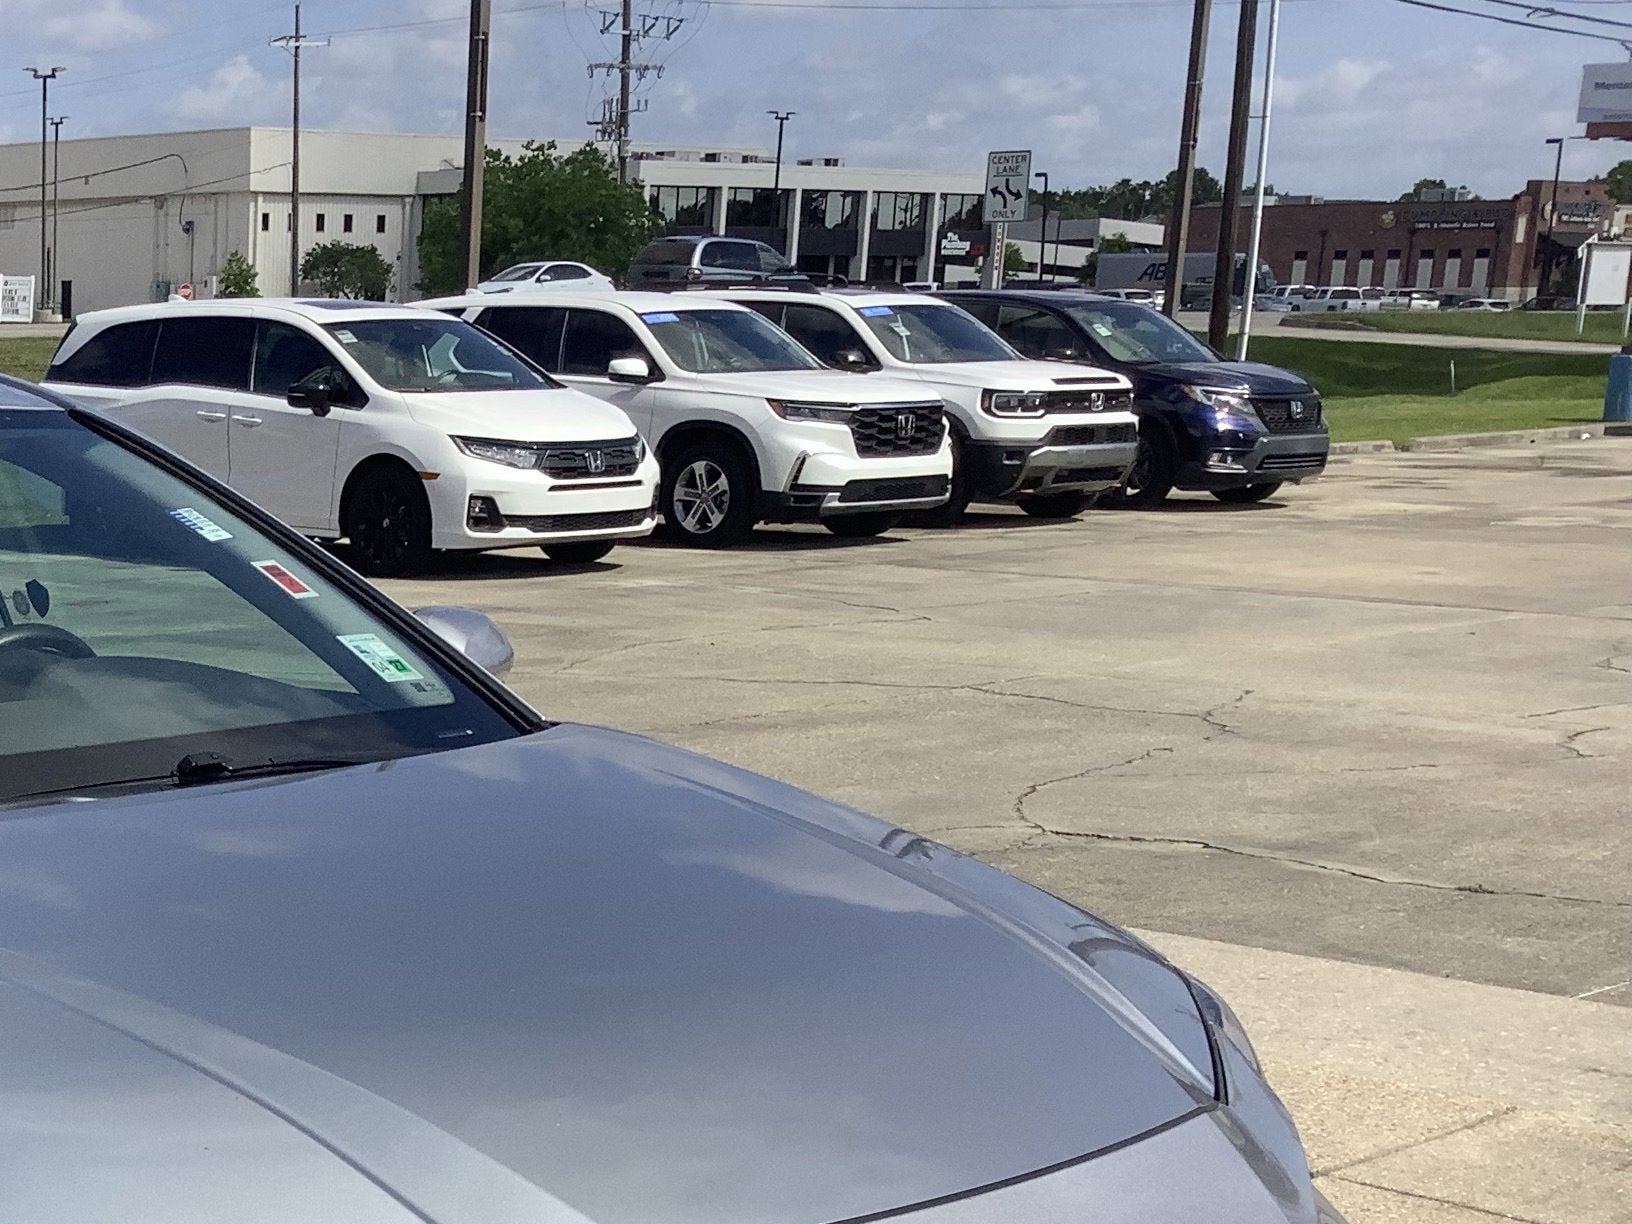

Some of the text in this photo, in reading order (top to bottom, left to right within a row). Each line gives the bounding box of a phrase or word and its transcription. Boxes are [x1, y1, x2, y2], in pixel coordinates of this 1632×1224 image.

[991, 154, 1027, 165] CENTER
[996, 165, 1021, 174] LANE
[992, 209, 1017, 219] ONLY
[1136, 262, 1169, 281] AB
